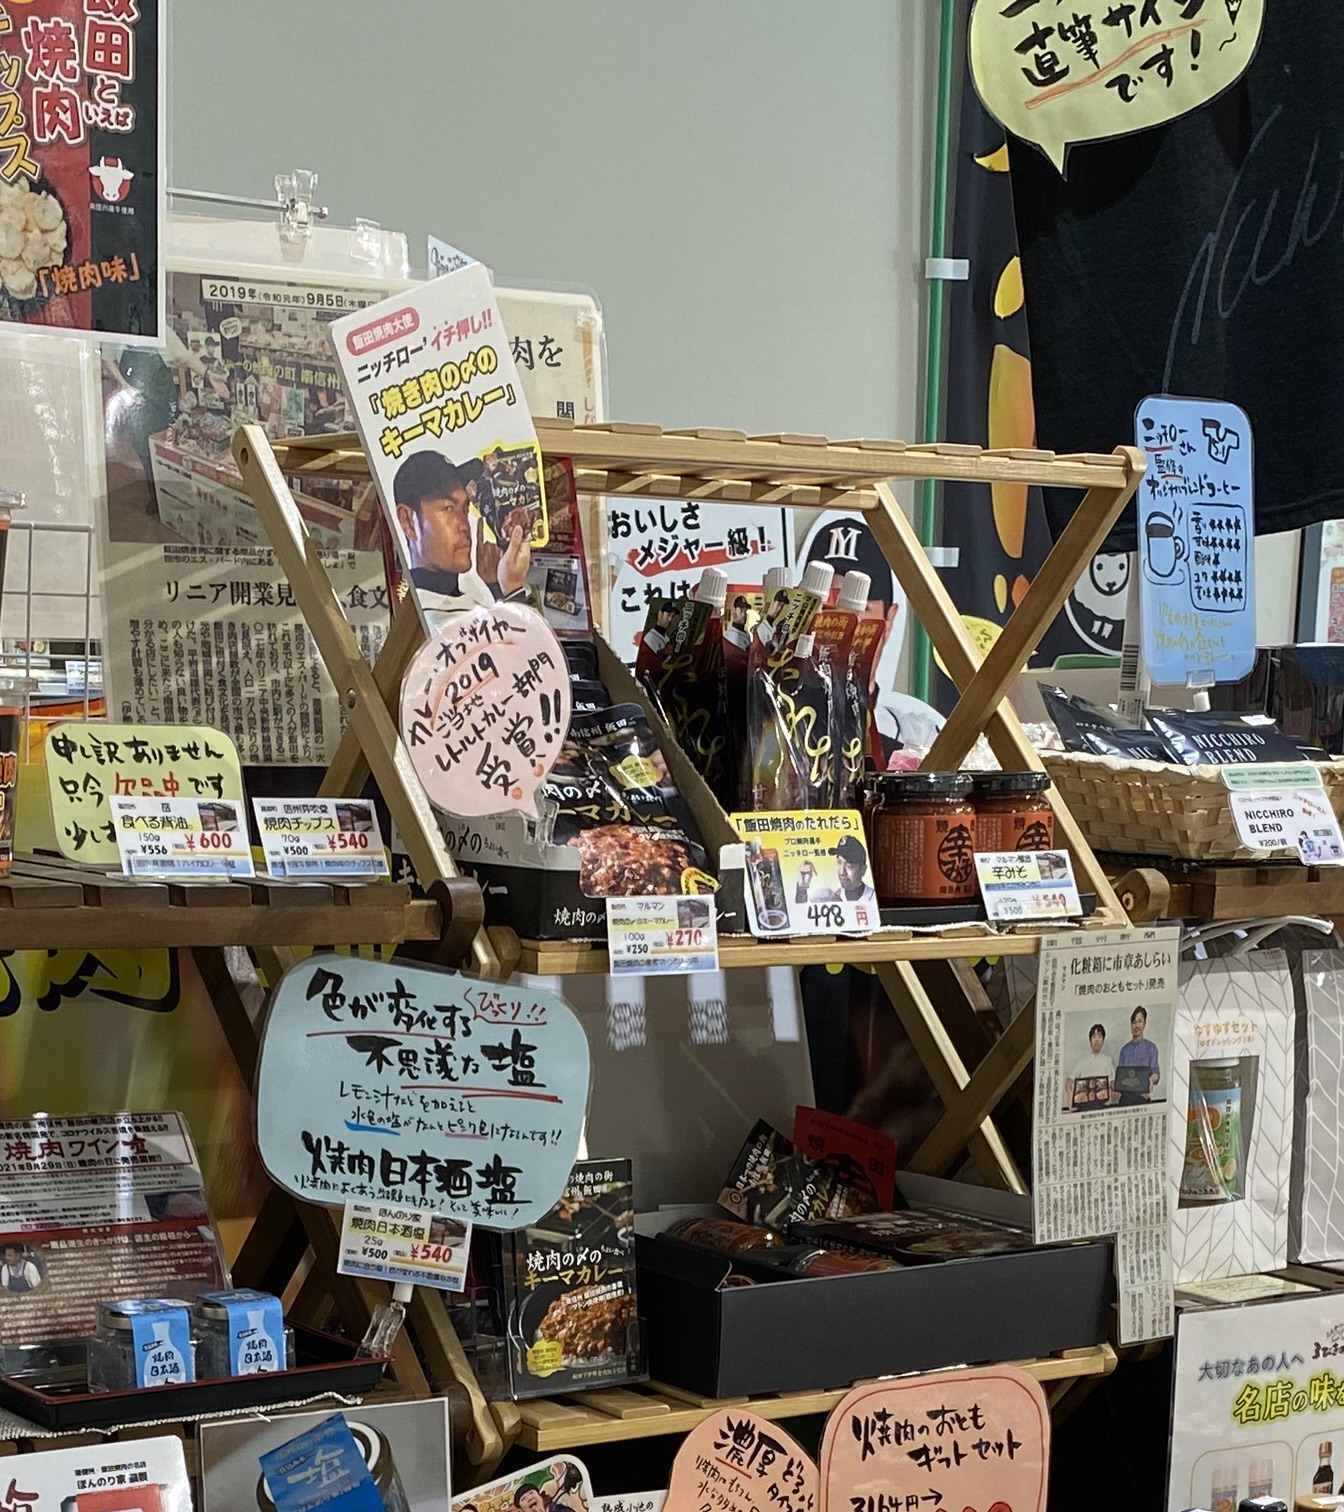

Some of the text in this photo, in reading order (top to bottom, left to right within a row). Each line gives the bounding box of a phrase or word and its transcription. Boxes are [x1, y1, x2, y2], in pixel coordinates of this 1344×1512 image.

[1104, 30, 1203, 102] です！
[23, 16, 87, 145] 焼肉
[35, 260, 140, 298] 「焼肉味」
[369, 345, 498, 420] 「焼き肉の〆の
[379, 384, 517, 459] キーマカレー」
[608, 502, 702, 539] おいしさ
[633, 521, 773, 568] メジャー級！
[166, 580, 297, 607] リニア開業見
[443, 654, 500, 700] 2019
[50, 733, 225, 767] 申し訳ありません
[1192, 730, 1267, 749] NICCHIRO
[59, 771, 225, 804] 只今欠品中です
[263, 816, 336, 831] 焼肉チップス
[735, 816, 862, 833] 「飯田焼肉のたれだら」
[1244, 807, 1294, 820] NICCHIRO
[184, 832, 233, 850] ¥600
[326, 833, 369, 850] ¥540
[1248, 823, 1284, 834] BLEND
[140, 845, 168, 855] ¥556
[283, 845, 309, 856] ¥500
[991, 864, 1028, 880] 辛みそ
[807, 901, 846, 928] 498
[665, 928, 703, 948] ¥270
[1069, 951, 1172, 977] 化粧箱に市章あしらい
[1071, 978, 1166, 998] 「焼肉のおともセット」発売
[305, 967, 473, 1038] 色が変化する
[477, 991, 548, 1021] びっくり!!
[1193, 1020, 1258, 1037] ゆずゆずセット
[346, 1029, 548, 1089] 不思議な塩
[301, 1130, 534, 1205] 焼肉日本酒塩
[350, 1216, 426, 1240] 焼肉日本酒塩
[361, 1247, 388, 1261] ¥500
[409, 1243, 453, 1265] ¥540
[523, 1266, 625, 1292] キーマカレー
[1198, 1351, 1305, 1383] 大切なあの人へ
[852, 1402, 987, 1463] 焼肉のおとも
[906, 1428, 1024, 1473] ギフトセット
